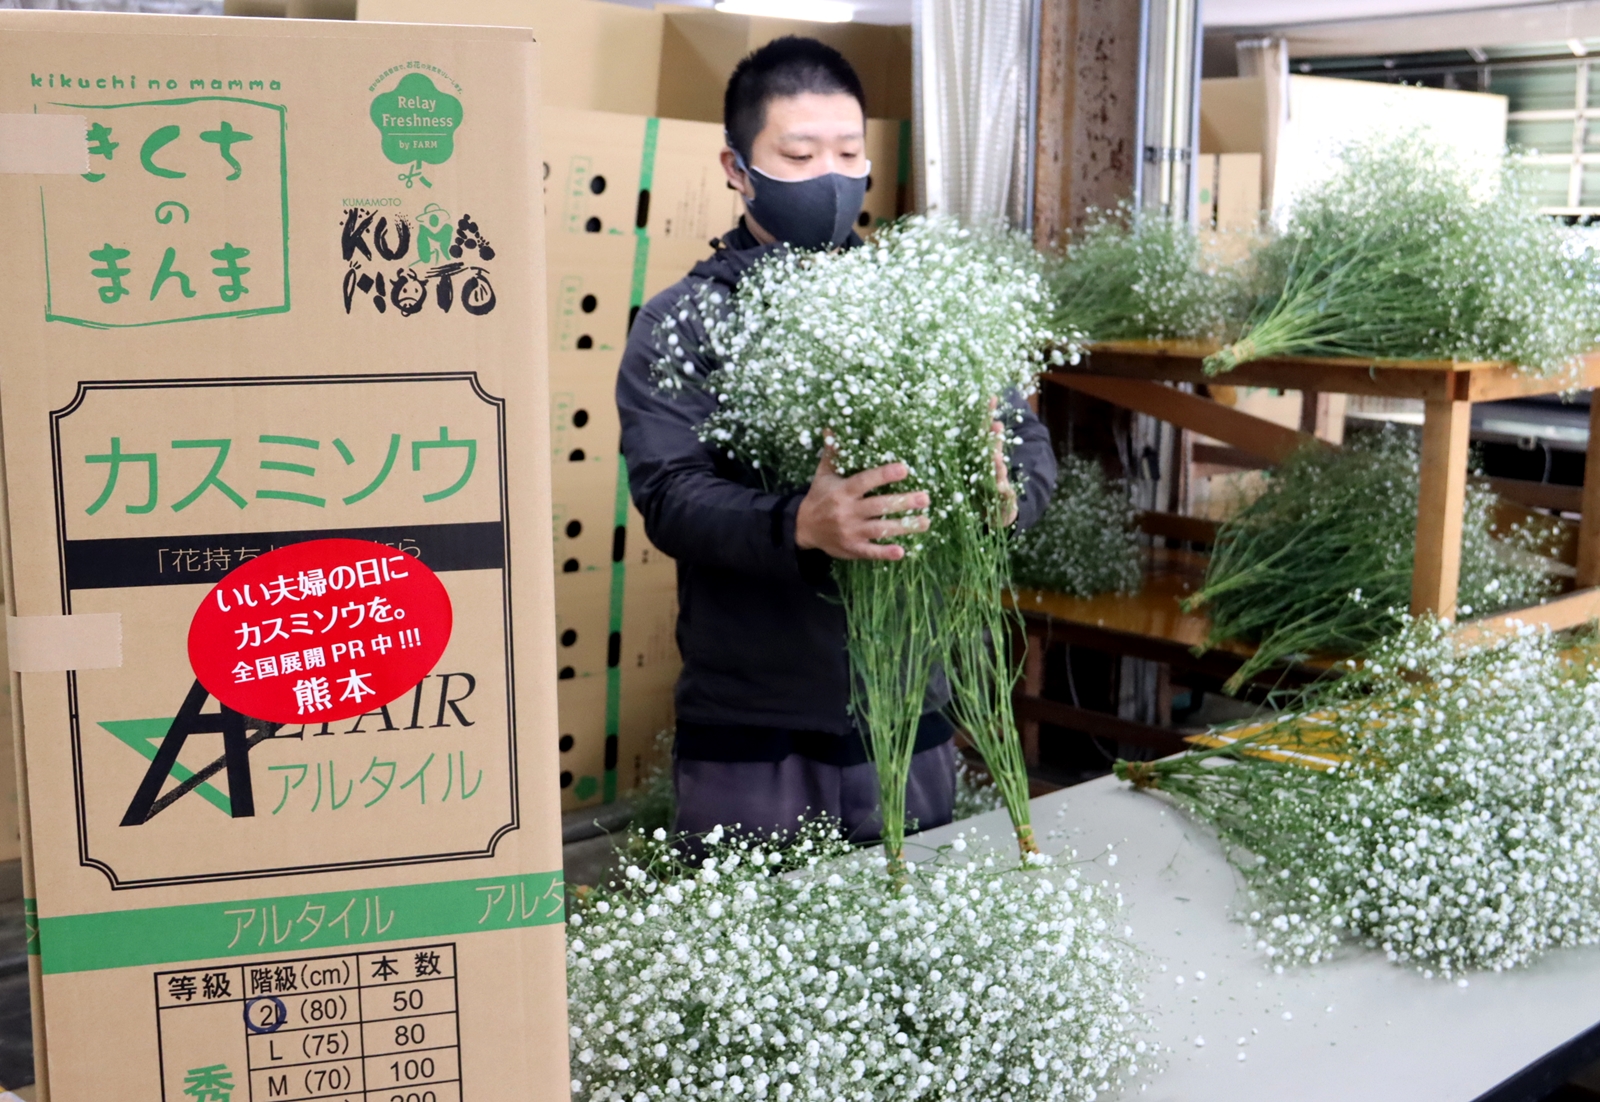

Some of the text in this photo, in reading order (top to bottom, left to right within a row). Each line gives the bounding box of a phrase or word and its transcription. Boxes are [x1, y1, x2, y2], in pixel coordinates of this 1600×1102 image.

[31, 73, 281, 90] kikuchi no mamma
[397, 96, 436, 112] Relay
[382, 113, 453, 127] Freshness
[399, 140, 438, 149] by FARM
[155, 200, 189, 224] の
[342, 198, 401, 207] KUMAMOTO
[89, 242, 251, 303] まんま
[84, 426, 477, 516] カスミソウ
[216, 555, 409, 613] いい夫婦の日に
[234, 595, 406, 650] カスミソウを。
[231, 646, 326, 684] 全国展開
[331, 639, 366, 663] PR
[370, 634, 393, 655] 中
[268, 751, 482, 815] アルタイル
[224, 895, 395, 948] アルタイル
[167, 972, 232, 1001] 等級
[250, 960, 351, 995] 階級(cm)
[300, 995, 347, 1024] (80)
[392, 988, 424, 1012] 50
[269, 1029, 349, 1061] L (75)
[394, 1023, 426, 1046] 80
[268, 1065, 352, 1097] M (70)
[389, 1057, 435, 1082] 100
